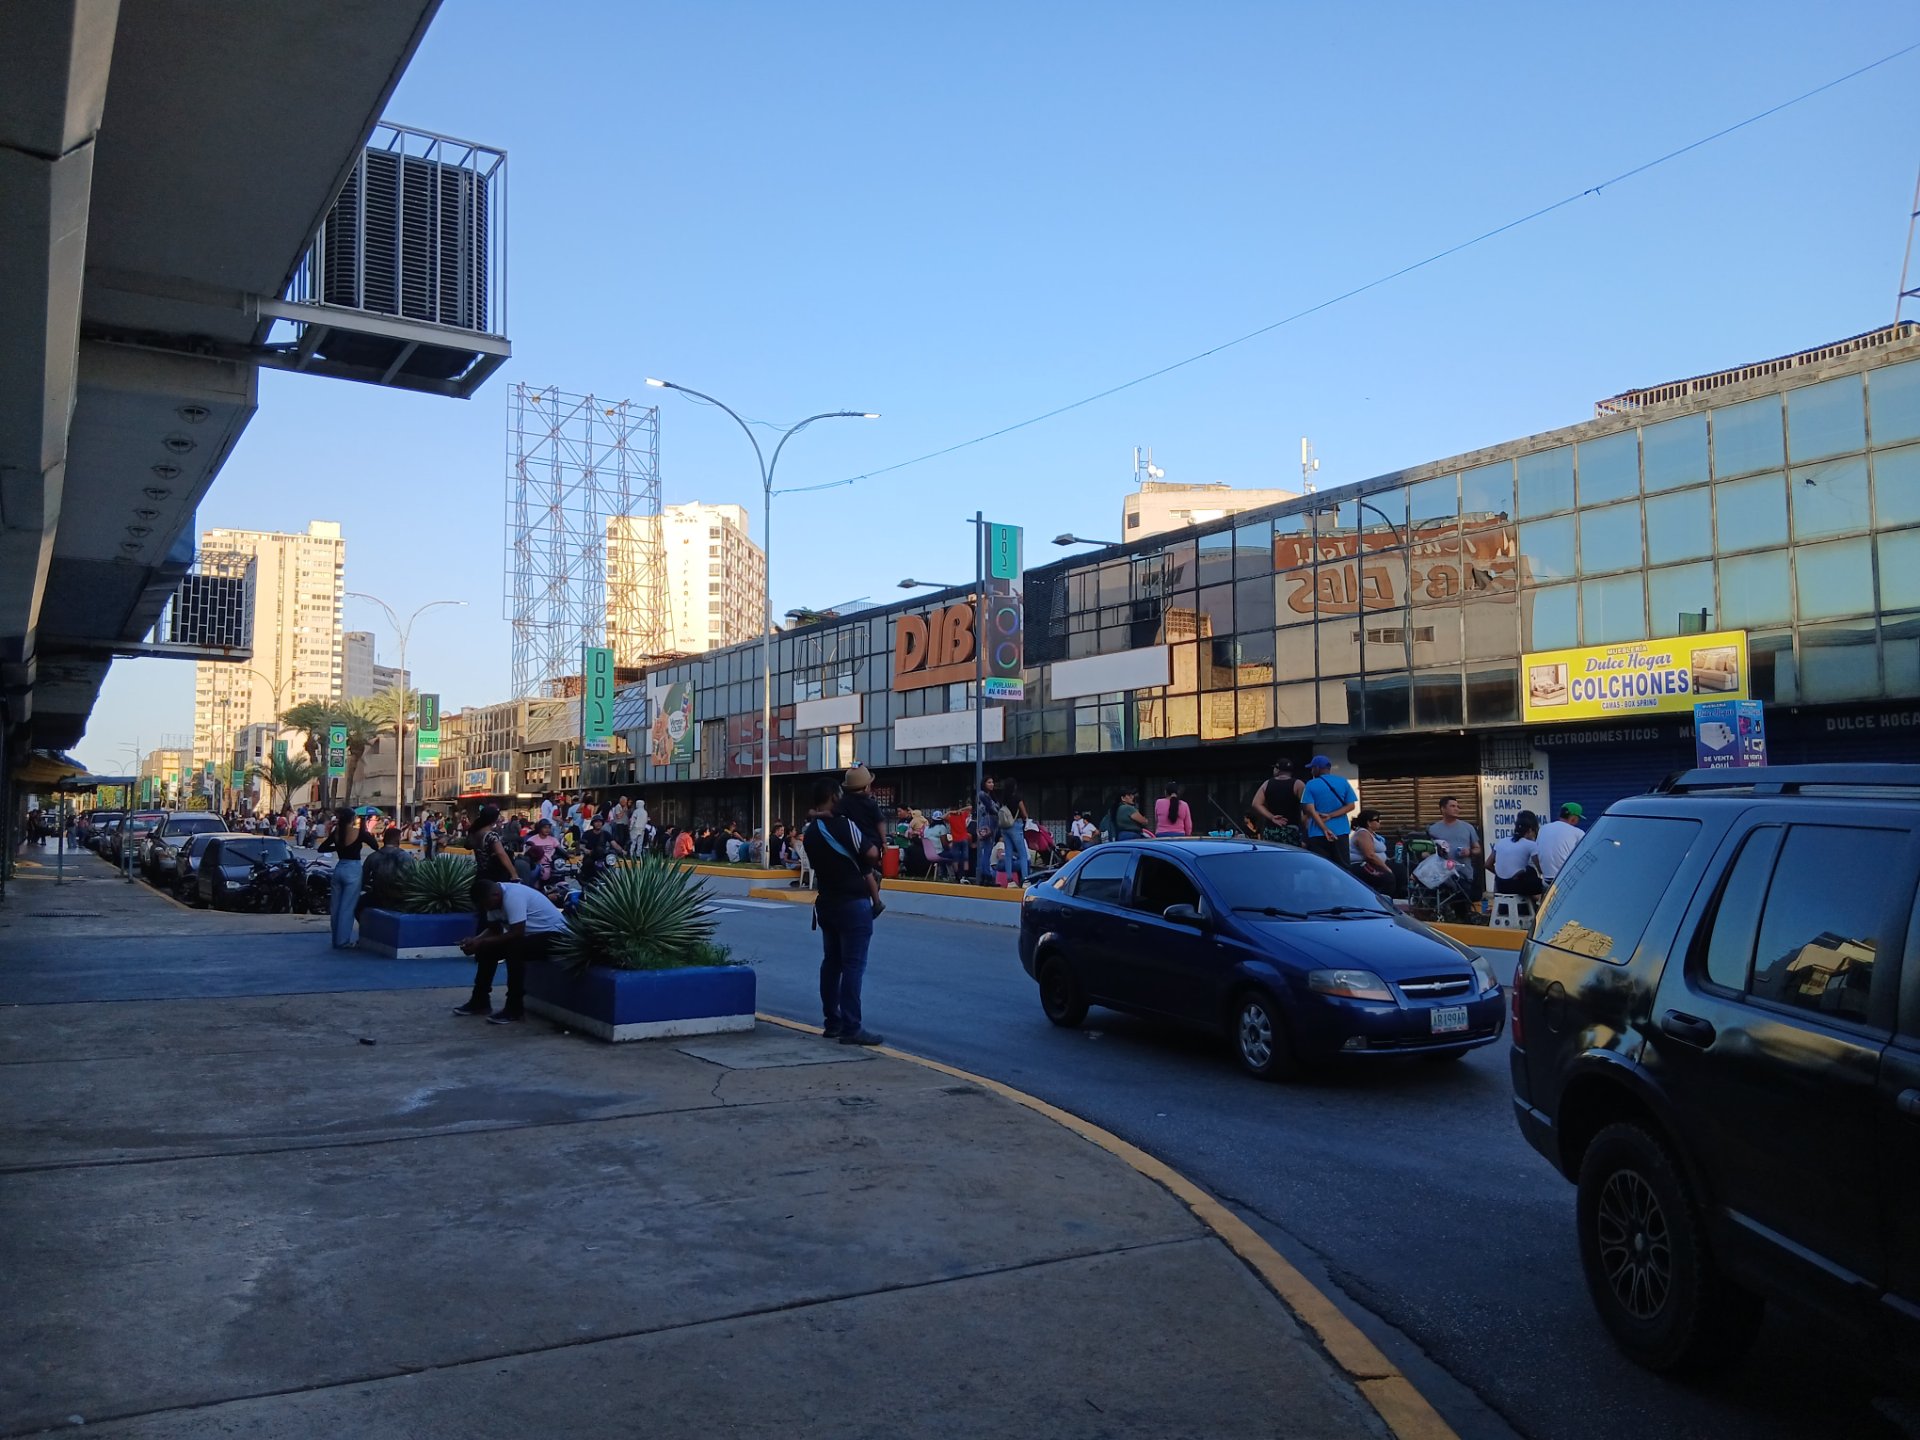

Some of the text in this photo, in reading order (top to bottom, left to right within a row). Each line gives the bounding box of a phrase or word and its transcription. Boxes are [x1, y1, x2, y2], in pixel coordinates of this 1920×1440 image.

[896, 603, 988, 674] DIB
[1585, 653, 1672, 672] Dulce Hogar
[1571, 669, 1690, 701] COLCHONES
[1602, 698, 1658, 709] CAMAS BOX SPRING
[1826, 714, 1875, 731] DULCE
[1534, 727, 1660, 746] ELECTRODOMESTICOS
[1493, 784, 1538, 796] COLCHONES
[1494, 799, 1522, 810] CAMAS
[1494, 814, 1516, 825] GOMA
